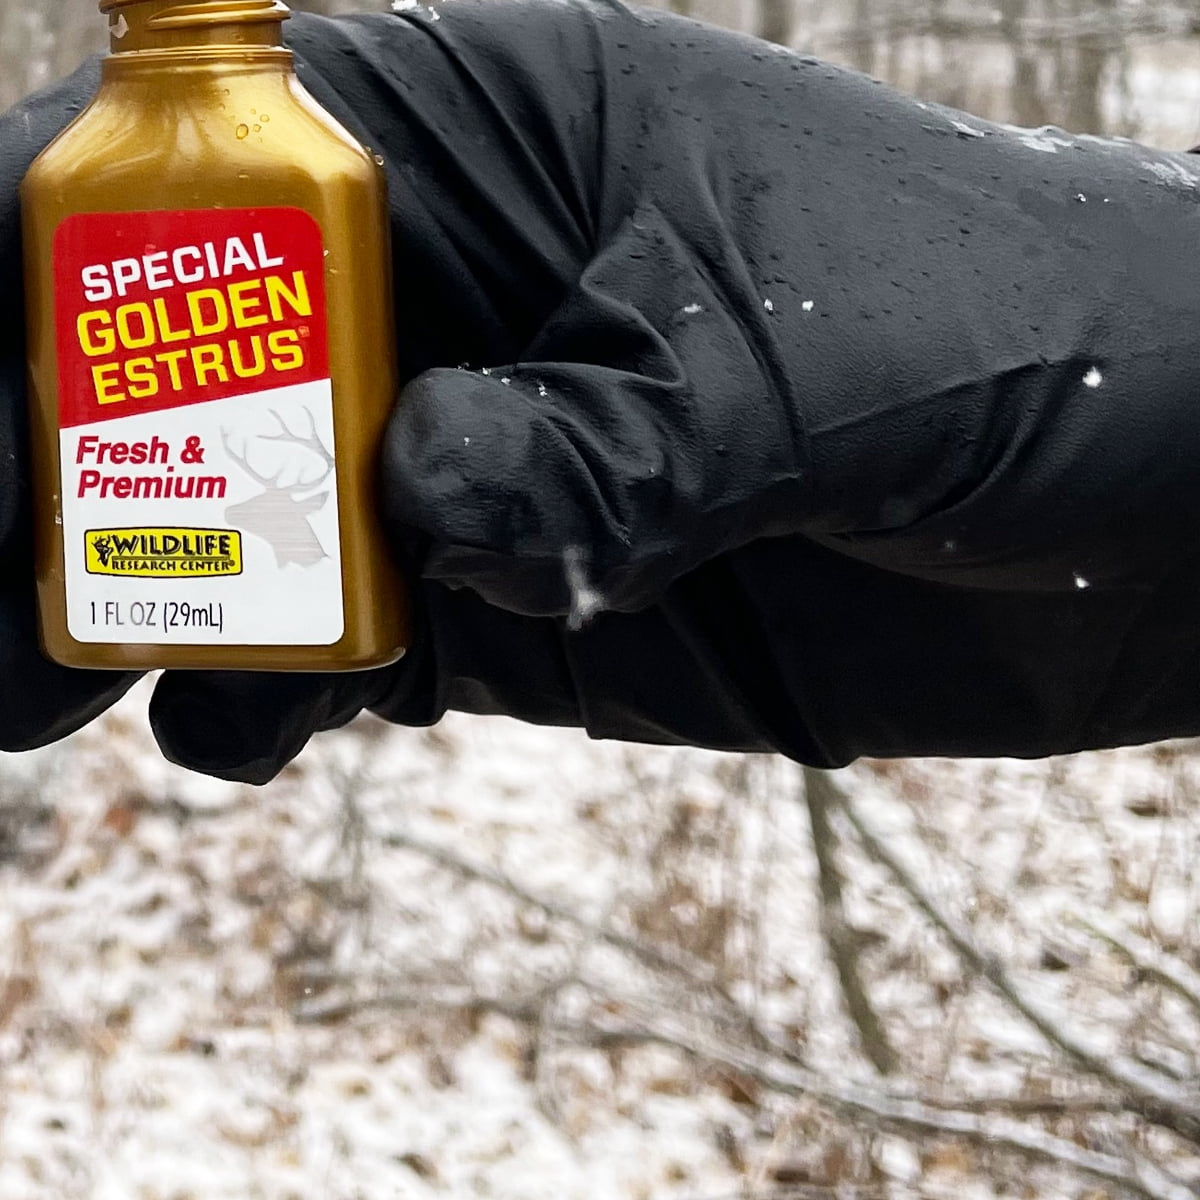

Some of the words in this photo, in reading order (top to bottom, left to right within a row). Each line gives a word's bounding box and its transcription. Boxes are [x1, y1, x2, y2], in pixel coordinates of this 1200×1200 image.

[81, 232, 285, 302] SPECIAL
[77, 270, 313, 357] GOLDEN
[76, 435, 169, 464] Fresh
[180, 435, 205, 464] &
[77, 466, 227, 498] Premium
[111, 535, 231, 556] WILDLIFE
[112, 560, 176, 571] RESEARCH
[90, 601, 96, 625] 1
[105, 601, 125, 625] FL
[130, 602, 156, 626] OZ
[163, 602, 223, 634] (29mL)
